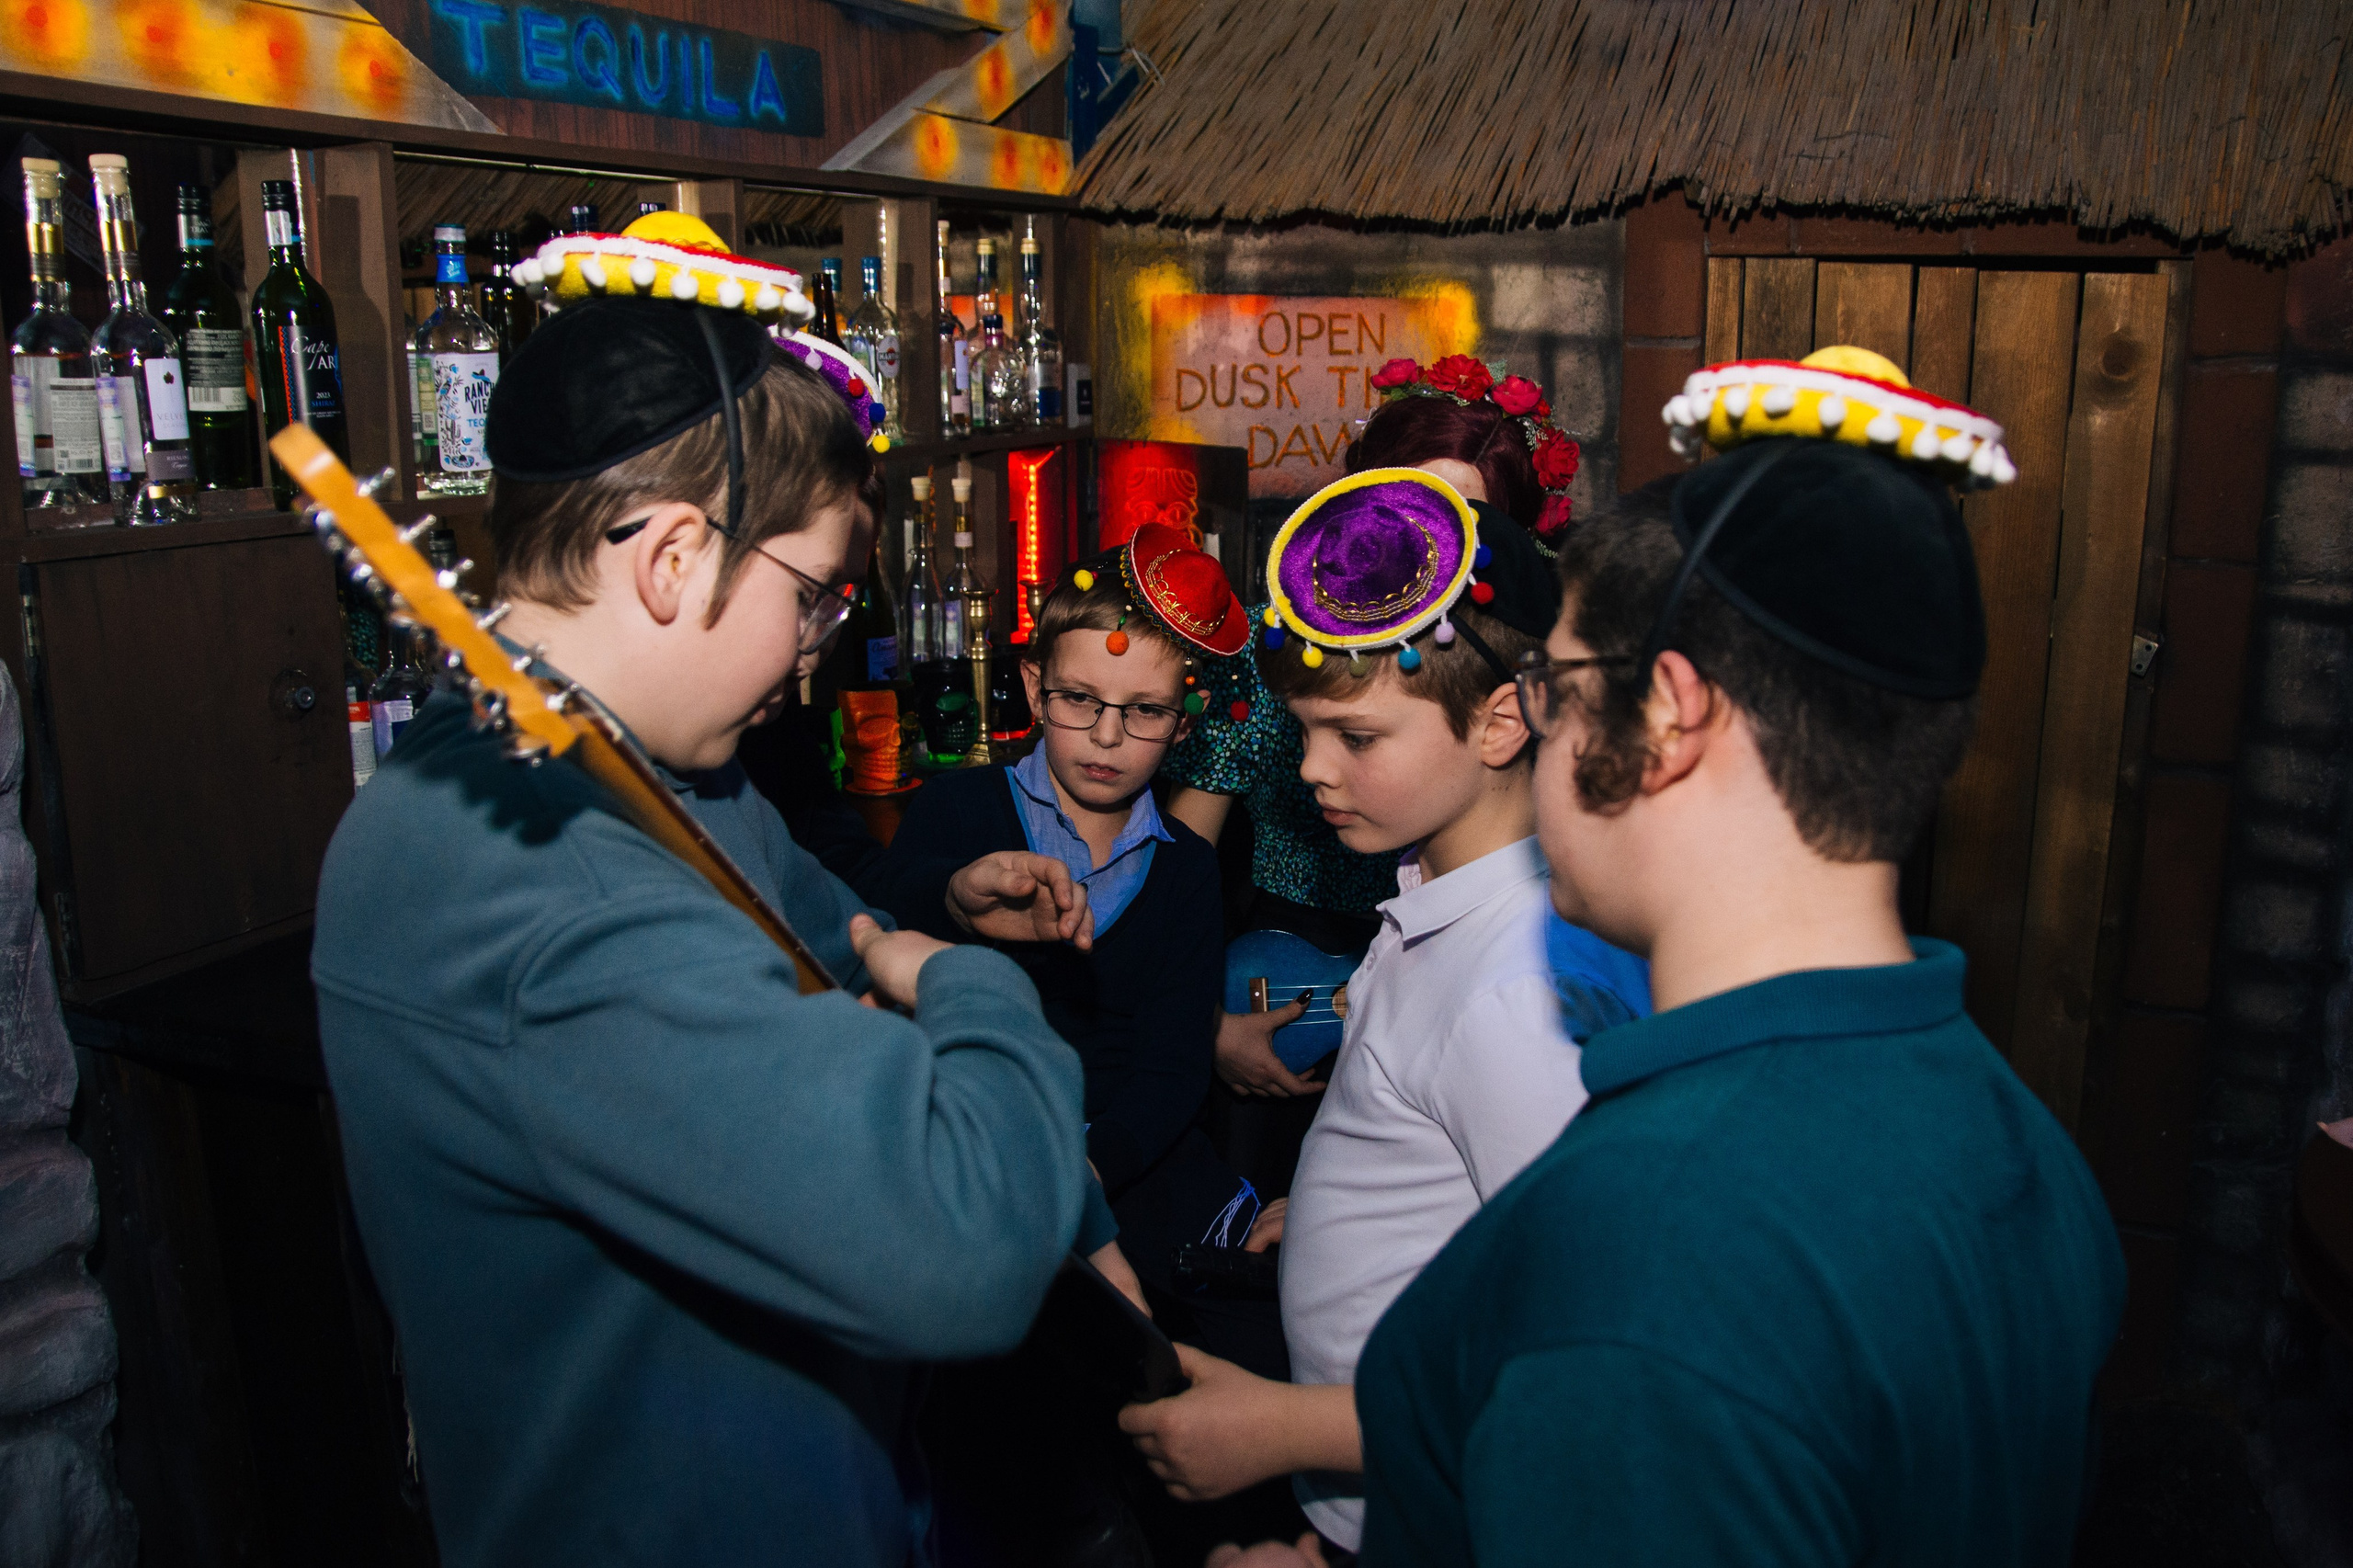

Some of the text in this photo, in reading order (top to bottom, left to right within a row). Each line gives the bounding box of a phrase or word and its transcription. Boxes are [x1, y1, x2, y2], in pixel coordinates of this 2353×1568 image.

[434, 0, 787, 121] TEQUILA
[290, 335, 330, 354] Cape
[1257, 311, 1386, 357] OPEN
[1175, 363, 1302, 412] DUSK
